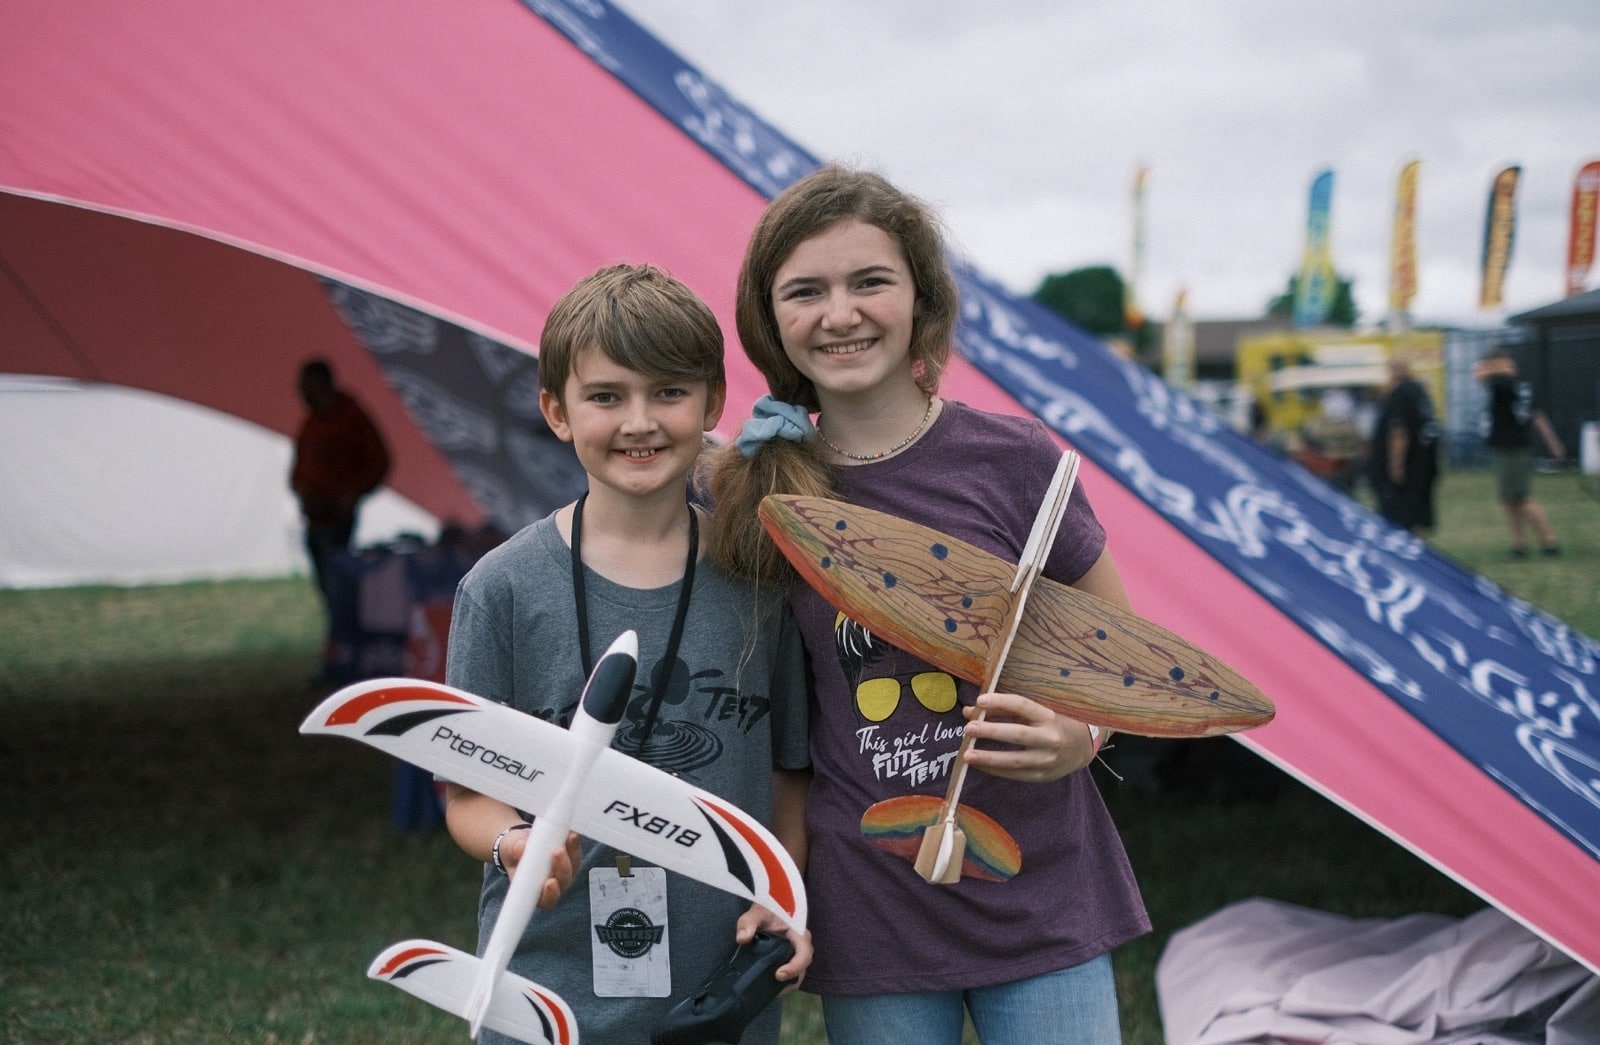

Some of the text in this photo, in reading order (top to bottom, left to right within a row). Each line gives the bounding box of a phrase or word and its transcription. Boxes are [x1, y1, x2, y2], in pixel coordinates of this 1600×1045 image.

[695, 687, 770, 735] TEST
[431, 725, 545, 783] Pterosaur
[856, 725, 889, 754] This
[893, 723, 929, 759] girl
[872, 749, 926, 781] FLITE
[902, 750, 960, 788] TEST
[603, 800, 702, 848] FX818
